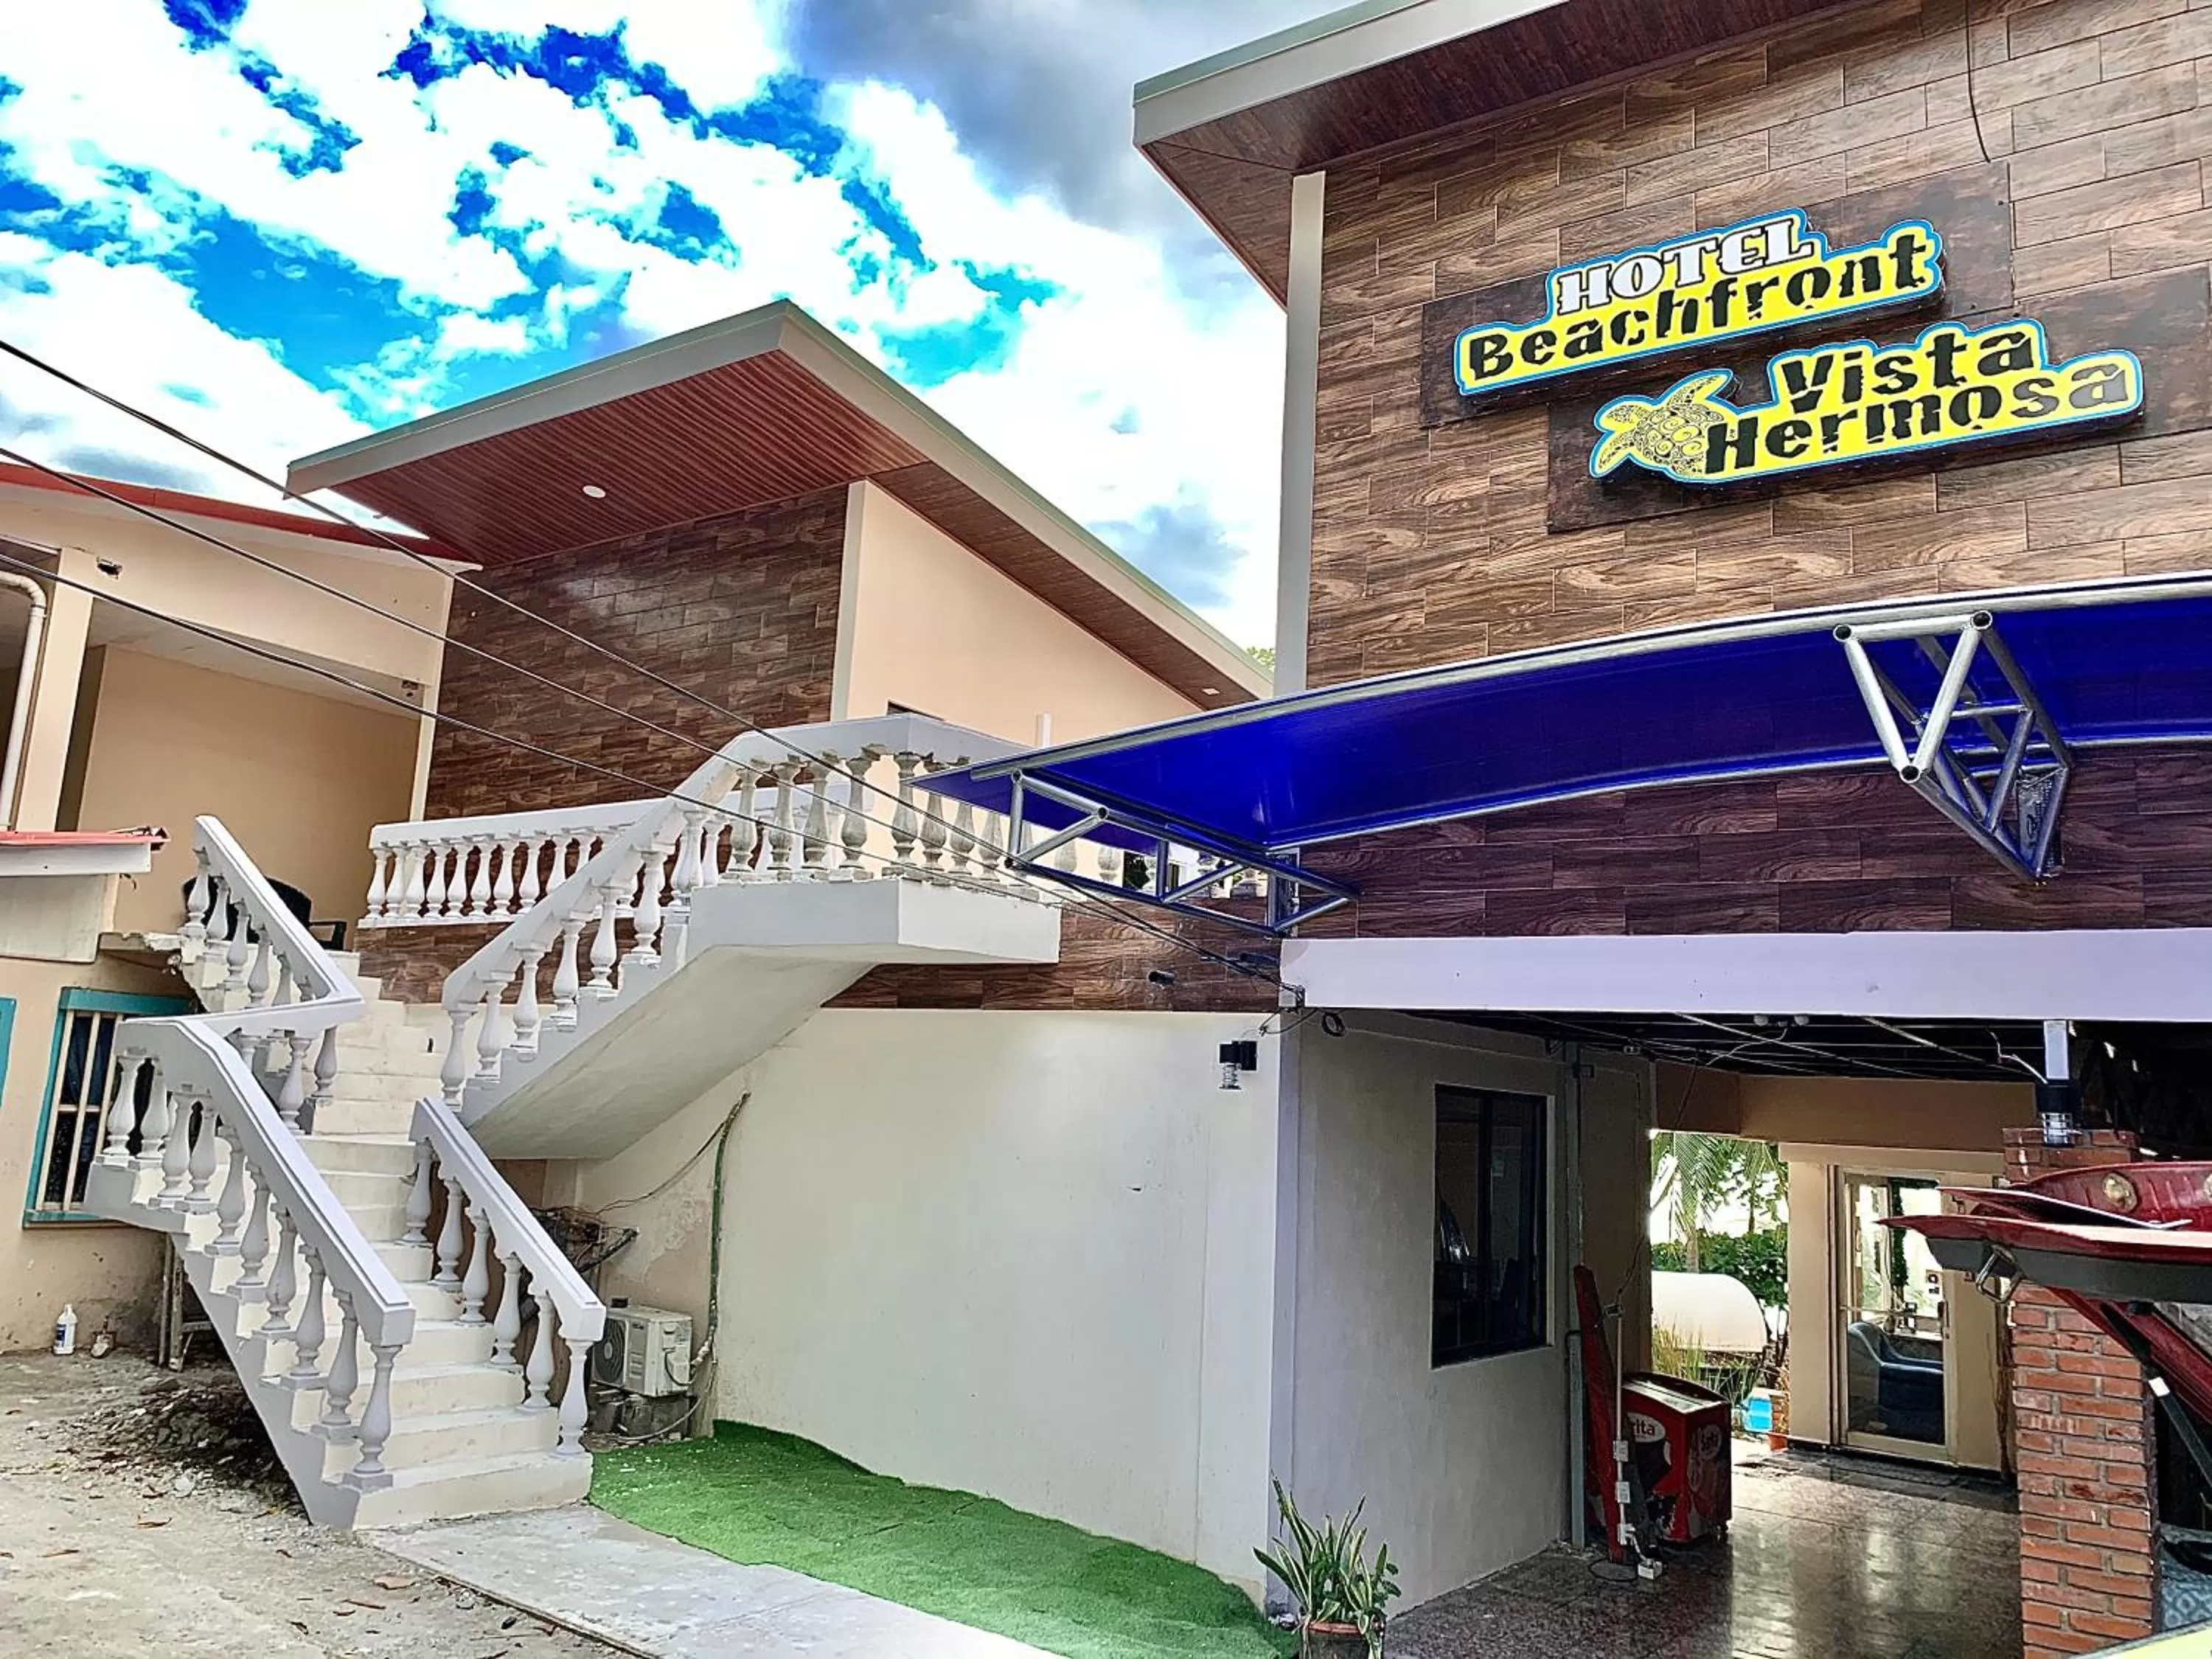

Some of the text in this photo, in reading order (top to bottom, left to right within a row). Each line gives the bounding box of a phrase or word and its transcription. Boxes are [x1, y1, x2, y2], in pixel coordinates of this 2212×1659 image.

[1469, 234, 1927, 380] Beachfront
[1557, 218, 1814, 316] HOTEL
[1705, 363, 2129, 474] Hermosa
[1781, 331, 2034, 414] Vista
